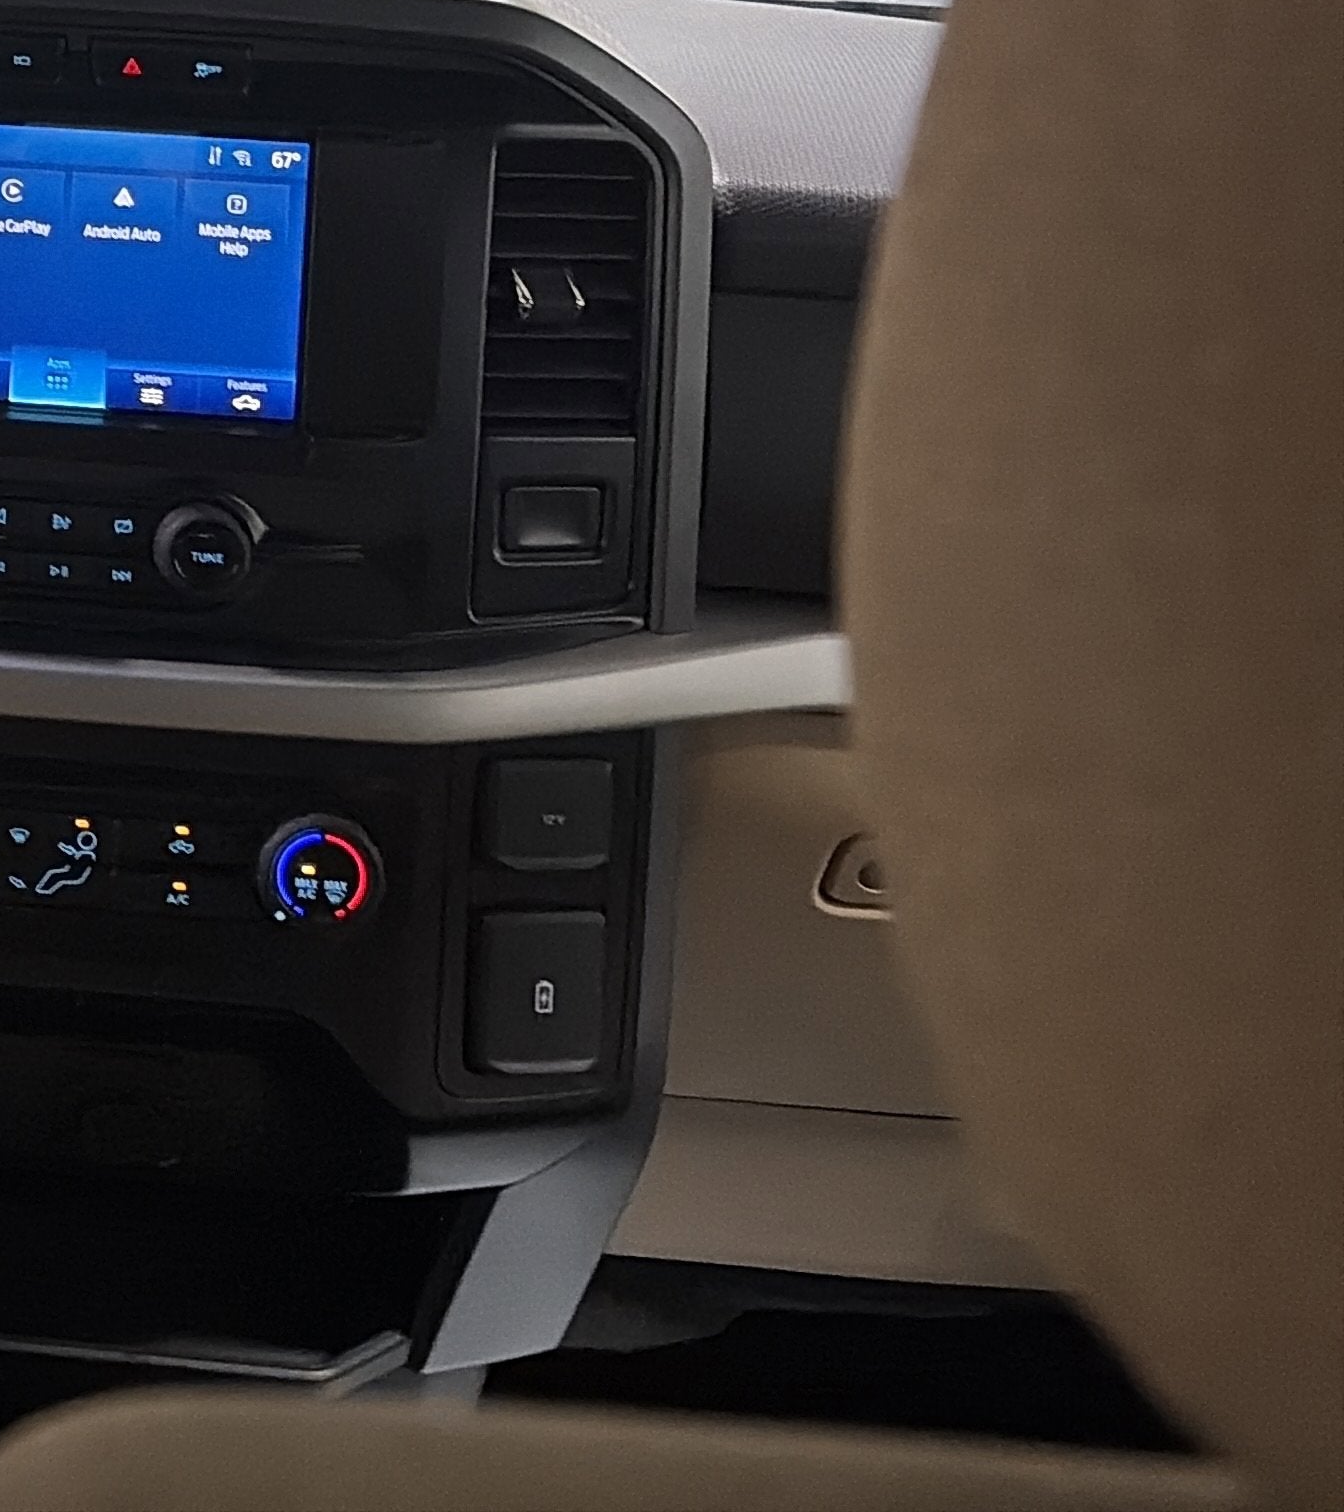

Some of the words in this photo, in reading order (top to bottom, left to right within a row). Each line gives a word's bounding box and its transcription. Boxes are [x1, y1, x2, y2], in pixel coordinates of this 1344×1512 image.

[271, 151, 302, 169] 67°
[5, 219, 52, 237] CarPlay
[82, 224, 131, 241] Android
[131, 226, 161, 242] Auto
[198, 223, 240, 239] Mobile
[240, 225, 272, 242] Apps
[219, 241, 249, 258] Help
[133, 372, 173, 387] Settings
[226, 378, 268, 393] Features
[190, 550, 225, 566] TUNE
[166, 893, 191, 906] A/C
